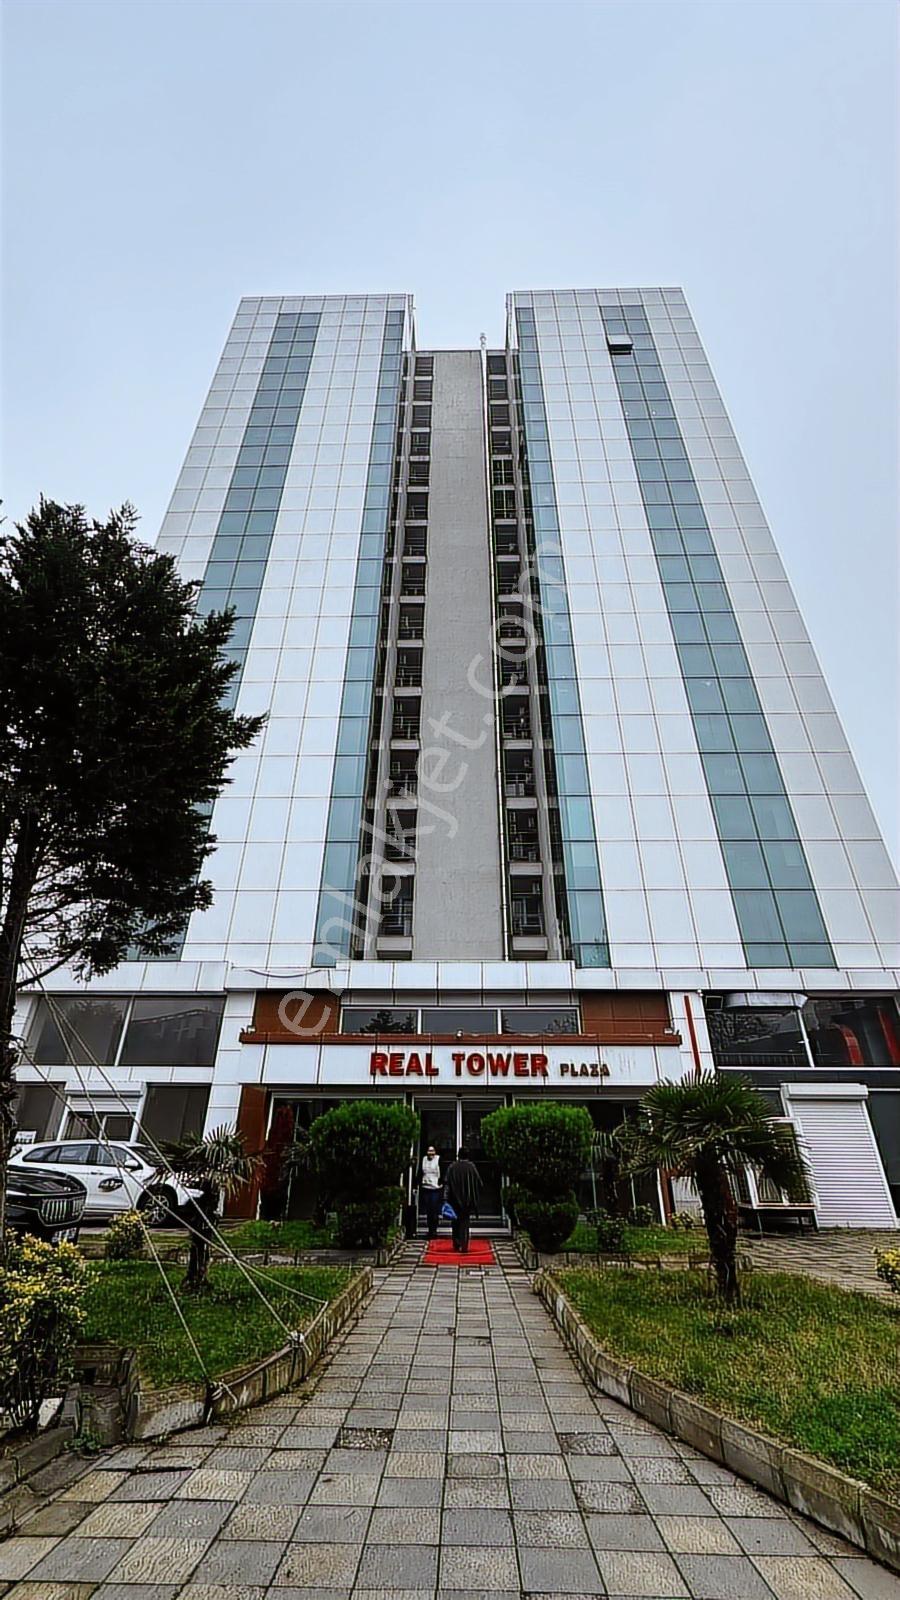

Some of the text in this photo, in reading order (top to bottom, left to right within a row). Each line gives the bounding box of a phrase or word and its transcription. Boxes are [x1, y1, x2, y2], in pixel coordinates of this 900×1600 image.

[370, 1053, 610, 1076] REAL TOWER PLAZA
